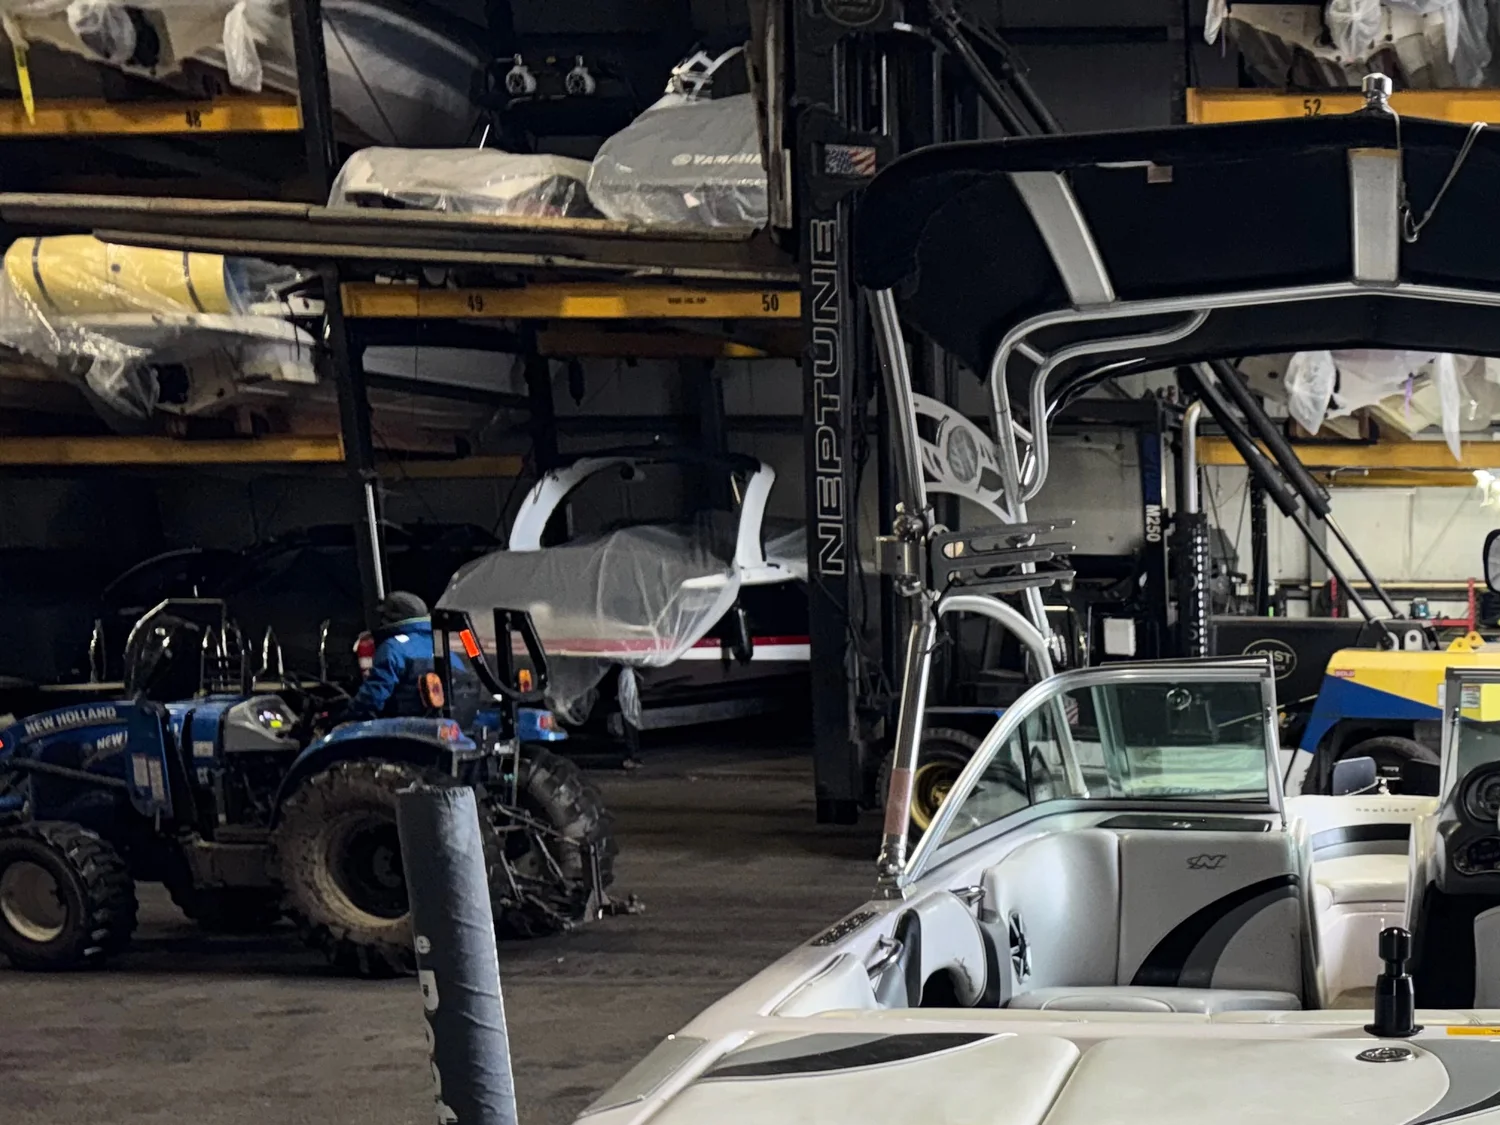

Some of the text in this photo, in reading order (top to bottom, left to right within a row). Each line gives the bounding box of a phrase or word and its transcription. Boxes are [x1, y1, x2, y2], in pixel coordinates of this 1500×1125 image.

[1303, 98, 1321, 117] 52
[467, 295, 484, 312] 49
[762, 293, 779, 312] 50
[811, 219, 845, 575] NEPTUNE
[1145, 504, 1161, 543] M250
[24, 706, 117, 735] NEW HOLLAND
[96, 731, 123, 750] NEW
